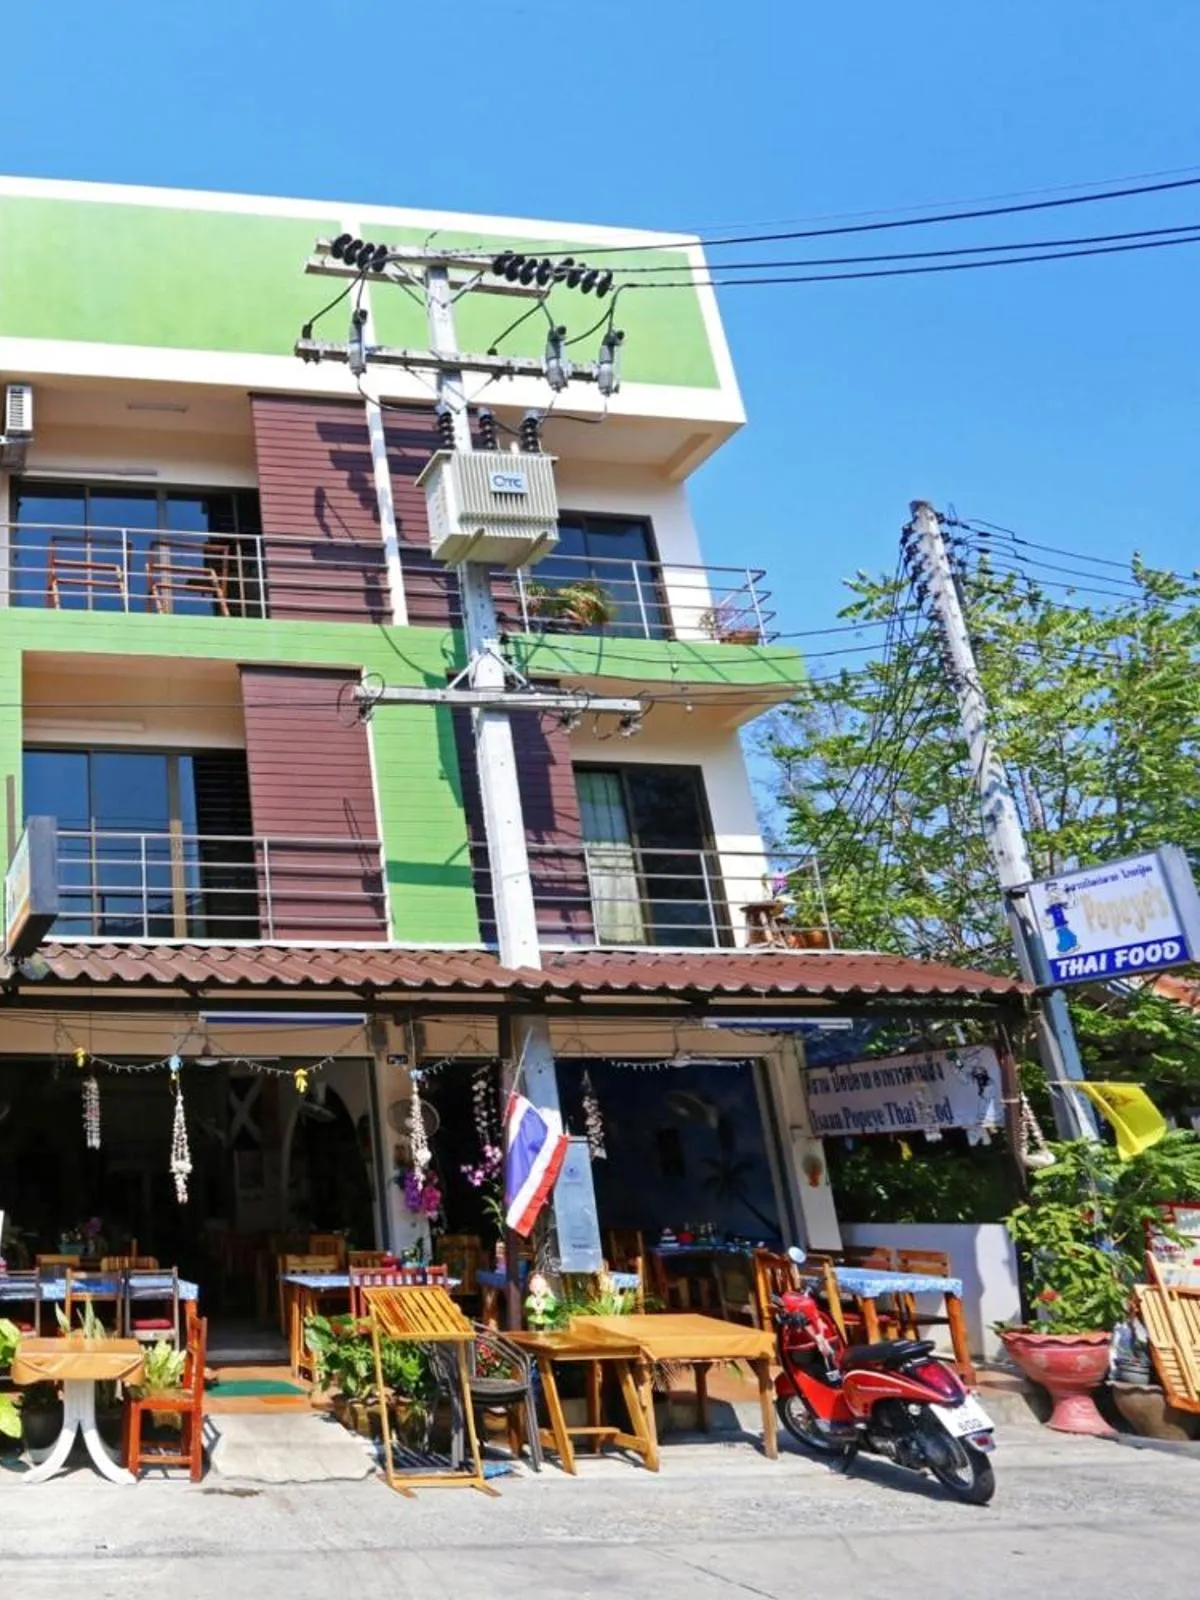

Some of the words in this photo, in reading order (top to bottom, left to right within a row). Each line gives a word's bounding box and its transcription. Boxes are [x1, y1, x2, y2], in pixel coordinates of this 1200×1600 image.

[1056, 954, 1108, 978] THAI
[1114, 941, 1181, 969] FOOD
[883, 1101, 917, 1126] Thai
